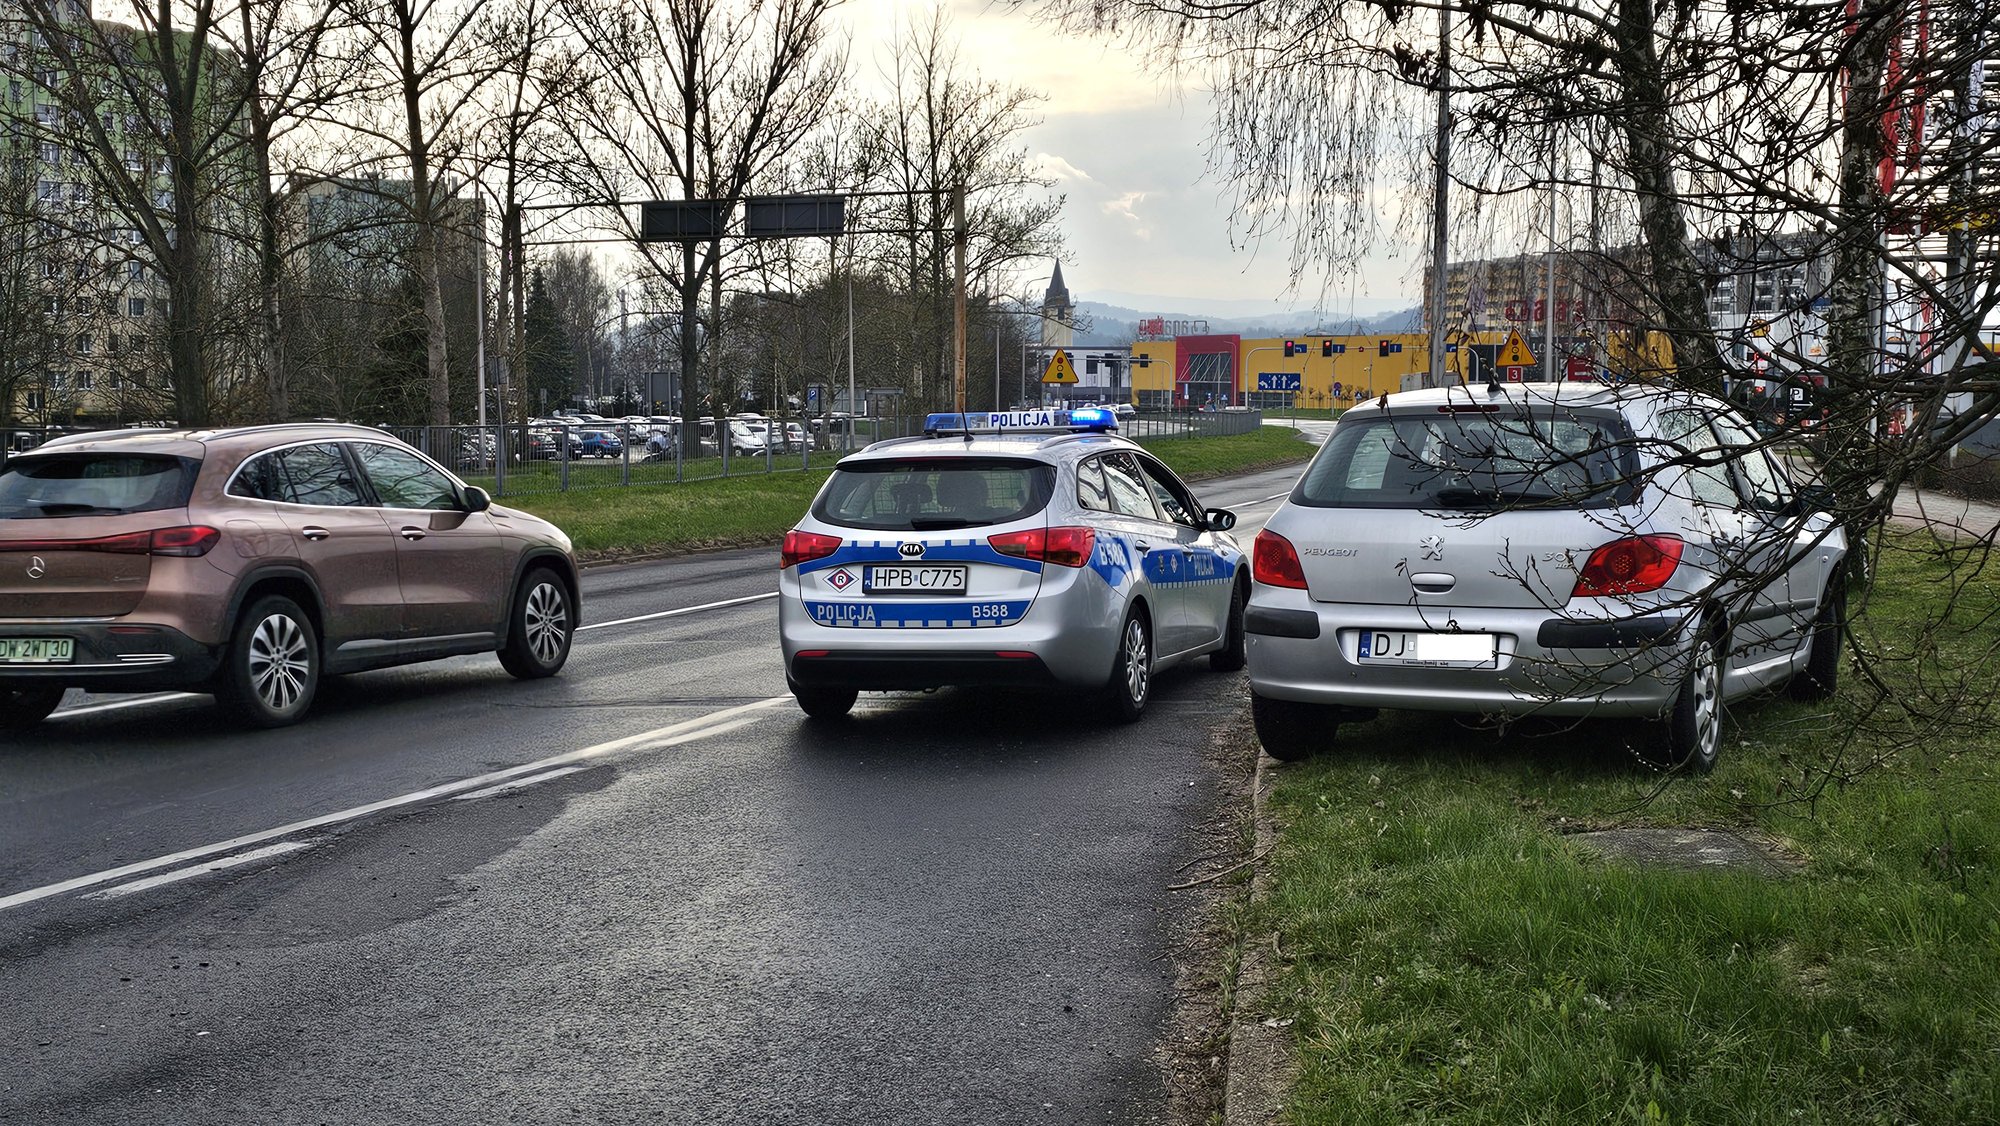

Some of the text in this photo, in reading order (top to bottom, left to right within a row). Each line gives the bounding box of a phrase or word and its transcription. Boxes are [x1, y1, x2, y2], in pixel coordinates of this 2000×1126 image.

[1511, 369, 1518, 380] 3
[991, 412, 1050, 427] POLICJA
[902, 543, 920, 554] KIA
[1098, 542, 1126, 567] B588
[1303, 547, 1358, 557] PEUGEOT
[1194, 553, 1214, 577] POLICJA
[837, 574, 844, 584] R
[875, 569, 962, 587] HPB C775
[817, 604, 876, 620] POLICJA
[972, 604, 1008, 618] B588
[0, 640, 69, 657] DW 2WT30
[1374, 633, 1406, 656] DJ
